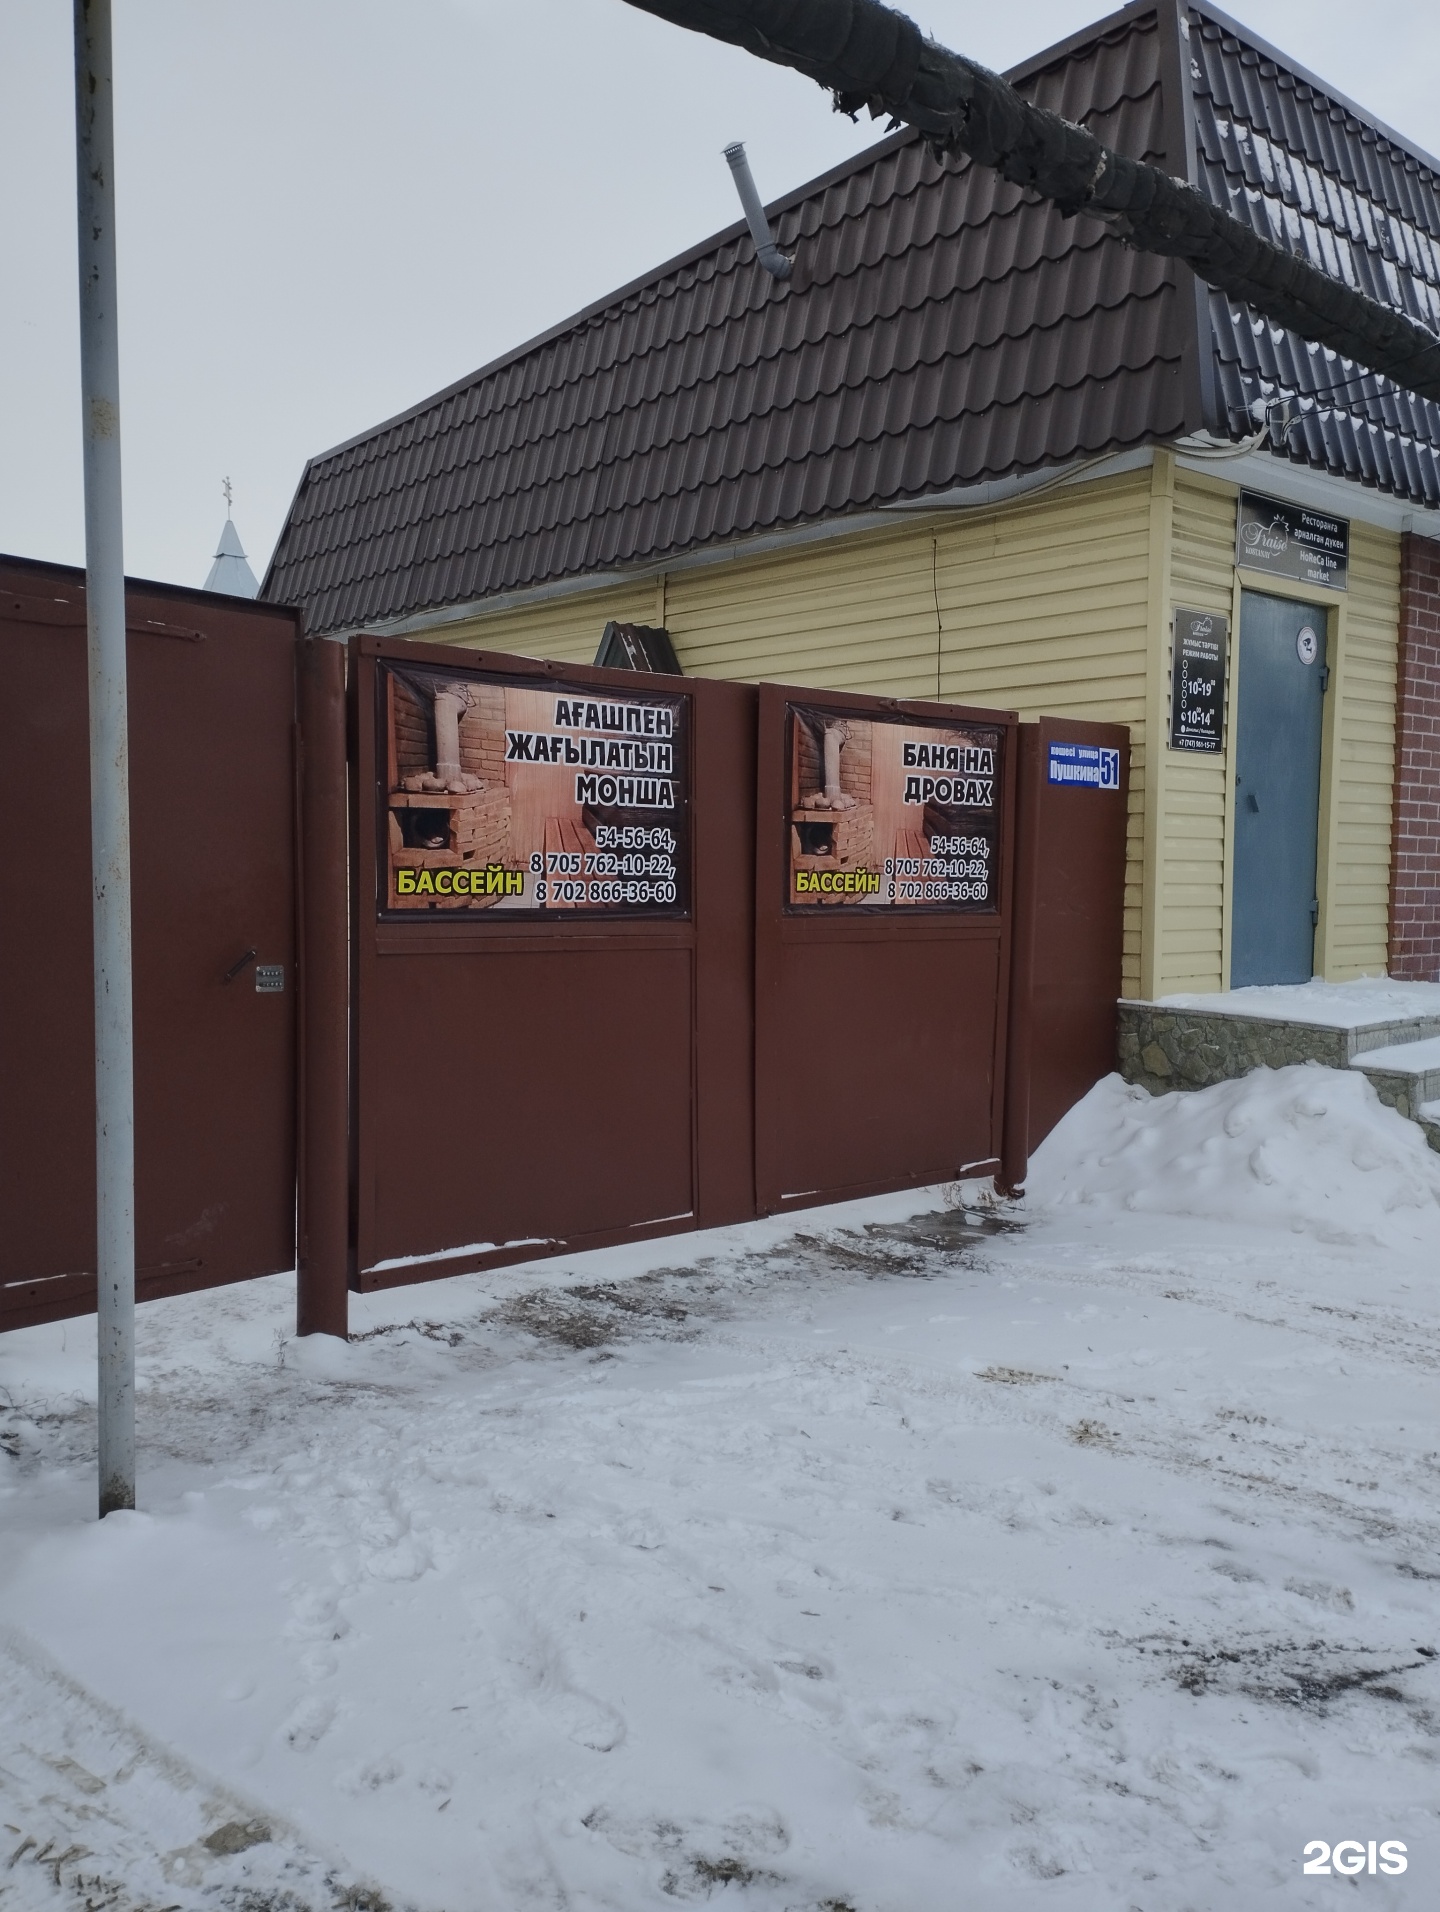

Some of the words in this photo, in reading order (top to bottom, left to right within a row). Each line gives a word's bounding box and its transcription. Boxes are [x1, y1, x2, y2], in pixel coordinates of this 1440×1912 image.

[1300, 550, 1325, 566] HoReCa
[1325, 556, 1338, 569] line
[1307, 569, 1330, 582] market
[1182, 649, 1200, 658] РЕЖИМ
[1200, 652, 1219, 661] РАБОТЫ
[555, 699, 673, 737] АҒАШПЕН
[505, 731, 673, 772] ЖАҒЫЛАТЫН
[903, 741, 961, 771] БАНЯ
[965, 747, 993, 774] НА
[1078, 749, 1099, 760] улица
[1050, 760, 1099, 782] Пушкина
[1100, 751, 1119, 785] 51
[575, 775, 675, 809] МОНША
[903, 775, 993, 806] ДРОВАХ
[596, 826, 676, 852] 54-56-64,
[930, 836, 990, 858] 54-56-64,
[529, 853, 542, 873] 8
[548, 854, 581, 875] 705
[585, 855, 676, 879] 762-10-22,
[884, 859, 893, 874] 8
[896, 859, 920, 875] 705
[922, 860, 988, 880] 762-10-22,
[397, 865, 524, 895] БАССЕЙН
[535, 882, 548, 901] 8
[552, 882, 586, 902] 702
[589, 882, 676, 902] 866-36-60
[796, 868, 880, 893] БАССЕЙН
[887, 883, 896, 898] 8
[899, 882, 923, 899] 702
[925, 882, 988, 900] 866-36-60
